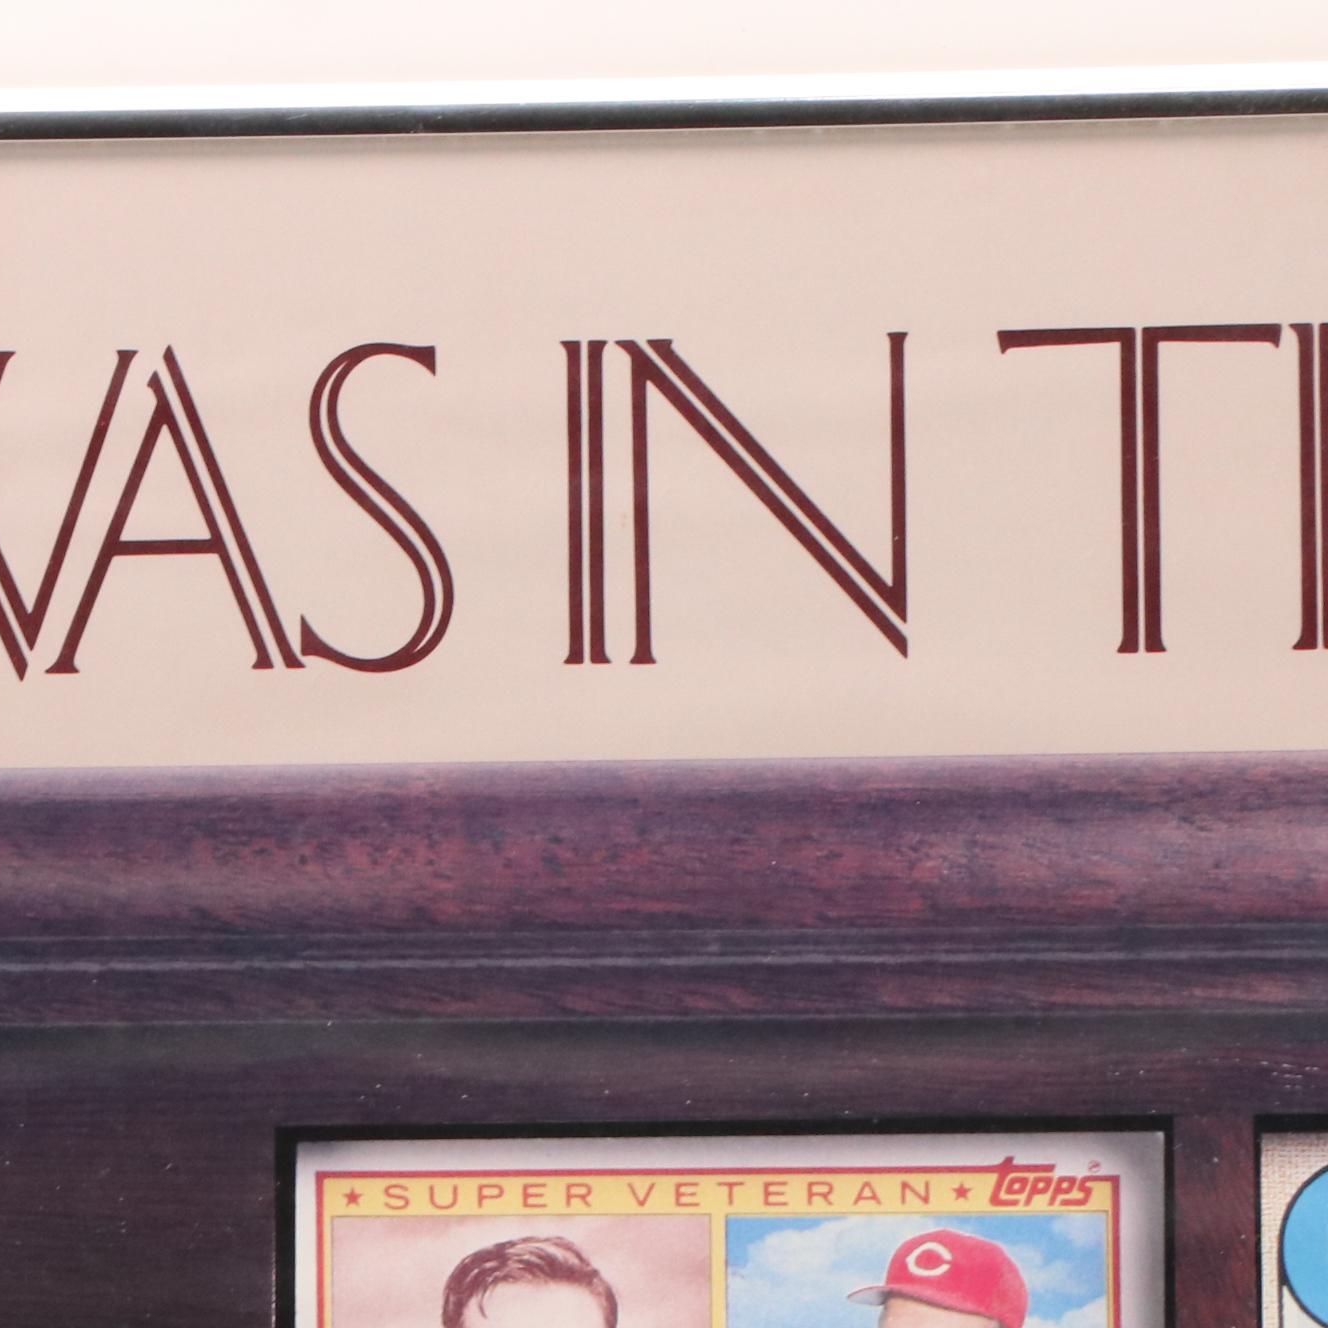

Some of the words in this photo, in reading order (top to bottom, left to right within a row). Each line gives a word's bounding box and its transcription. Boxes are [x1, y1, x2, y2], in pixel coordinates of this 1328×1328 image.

[559, 331, 910, 664] IN
[383, 1182, 593, 1211] SUPER
[629, 1180, 932, 1209] VETERAN
